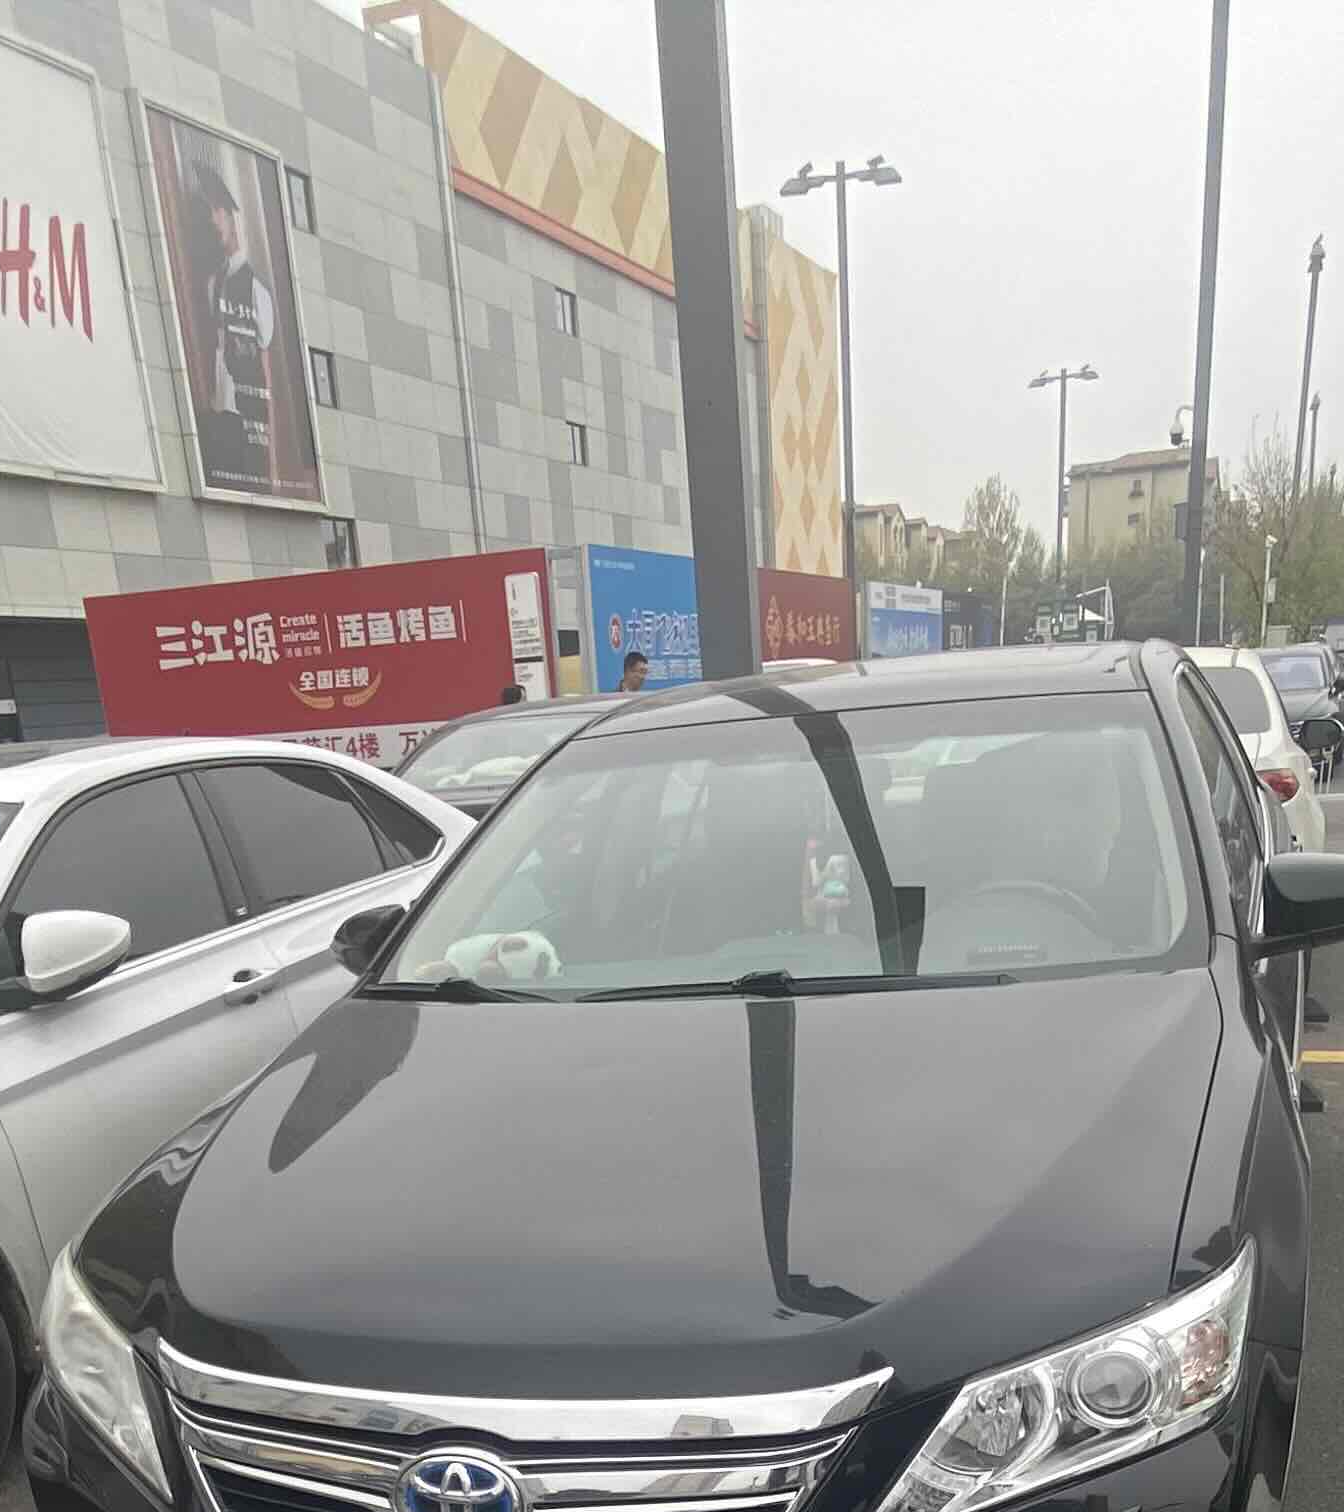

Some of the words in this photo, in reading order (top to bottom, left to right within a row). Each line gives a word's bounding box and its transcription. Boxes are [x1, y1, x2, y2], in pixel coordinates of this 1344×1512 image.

[279, 614, 319, 628] Create
[336, 605, 449, 649] 活鱼烤鱼
[155, 612, 280, 671] 三江源
[282, 629, 321, 643] miracle
[299, 666, 369, 691] 全国连锁
